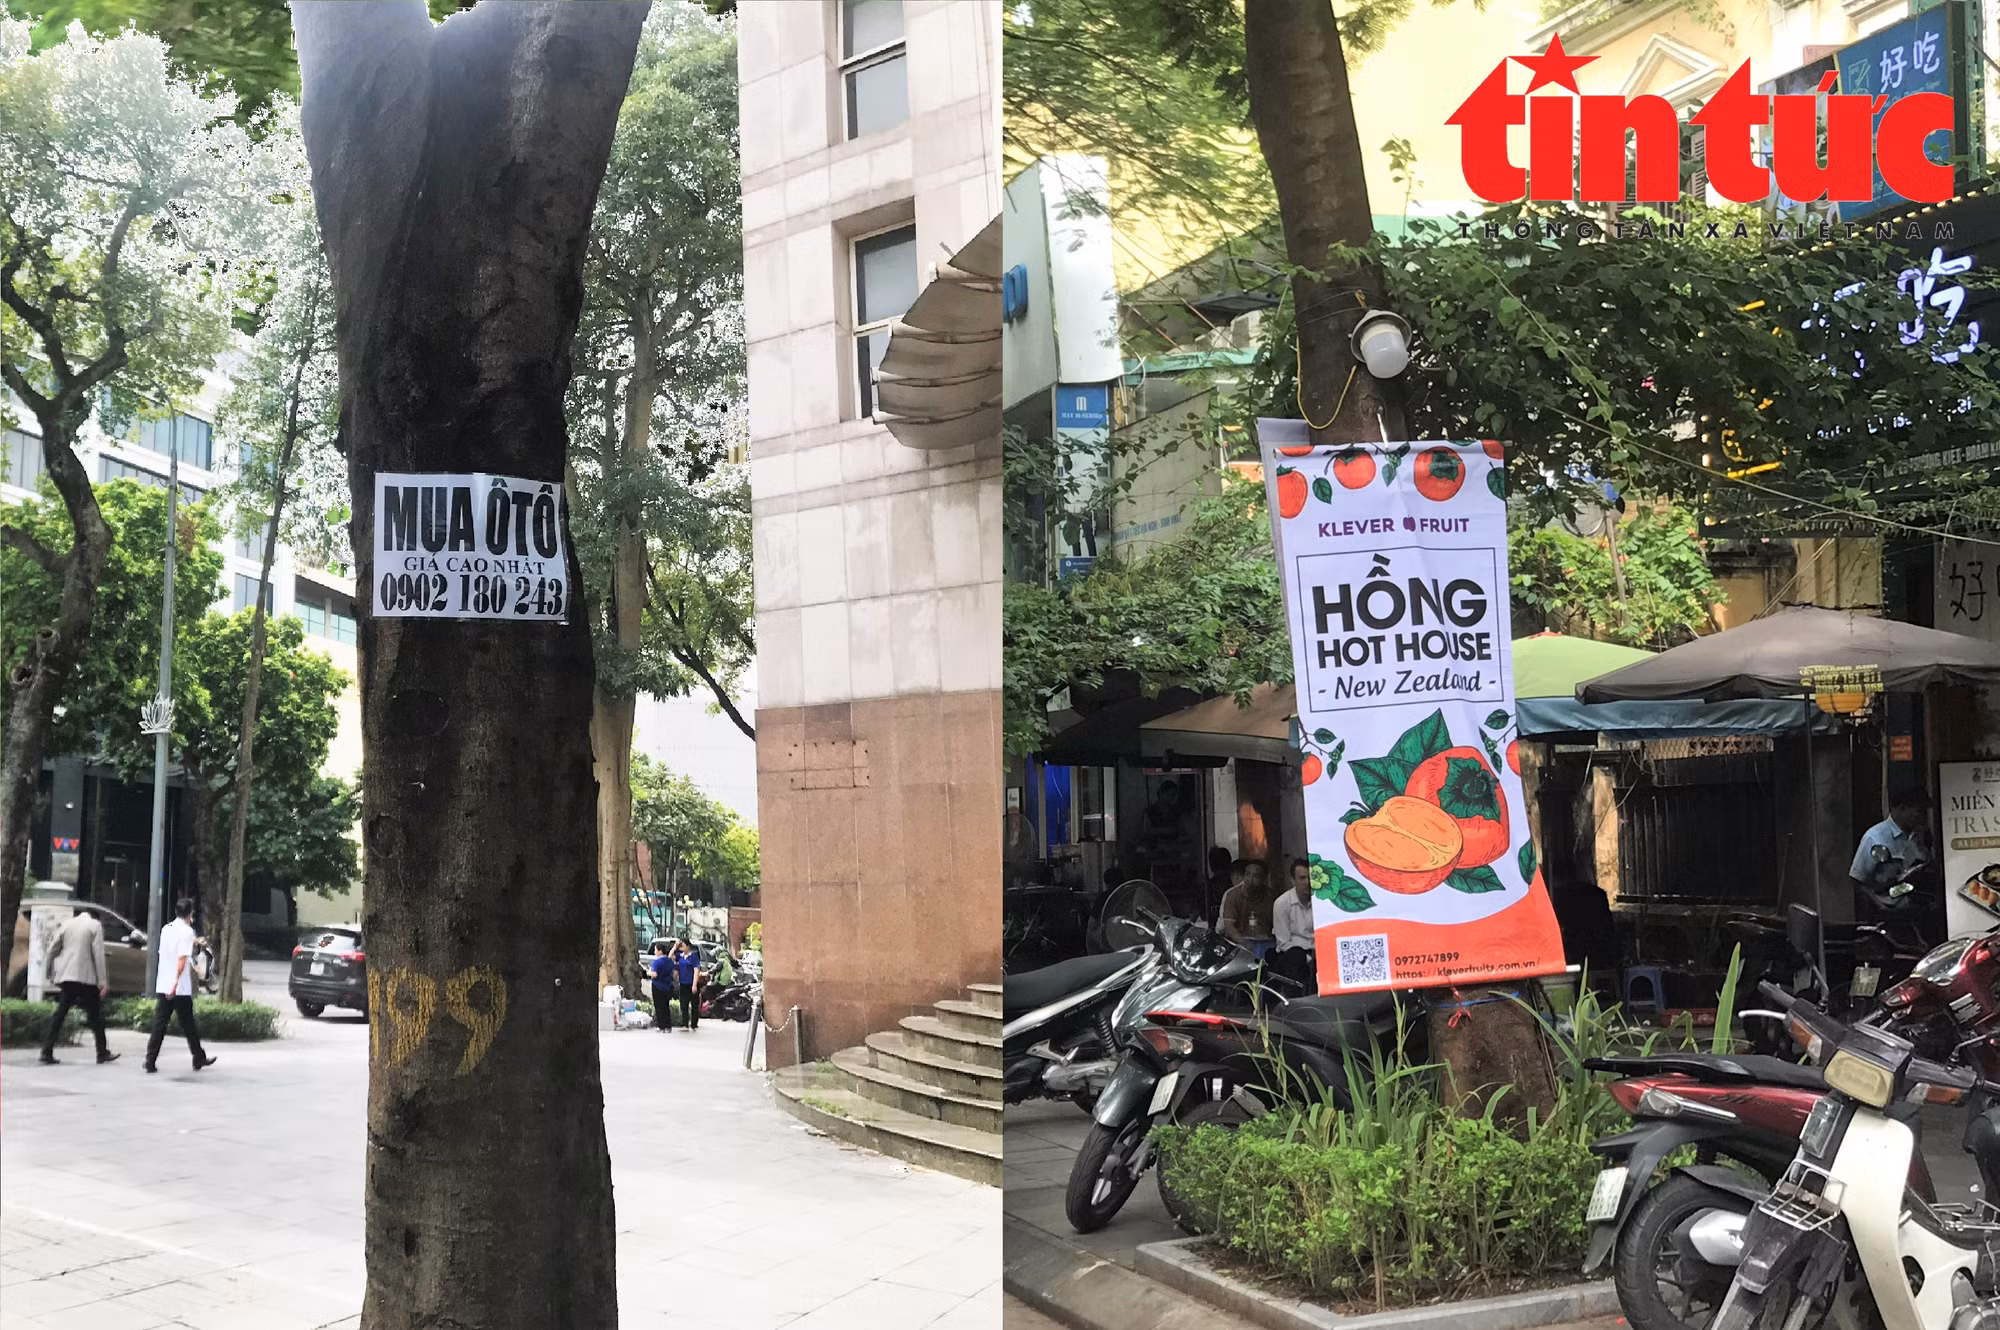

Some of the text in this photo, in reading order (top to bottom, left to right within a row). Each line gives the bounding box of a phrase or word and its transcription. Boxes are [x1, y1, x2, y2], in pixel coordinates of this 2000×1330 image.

[1880, 31, 1940, 93] 好吃
[383, 485, 476, 553] MUA
[1317, 517, 1470, 538] KLEVER FRUIT
[403, 553, 440, 572] GIÁ
[446, 558, 489, 573] CAO
[380, 572, 564, 616] 0902 180 243
[1311, 553, 1488, 635] HỒNG
[1948, 561, 2000, 621] 好
[1316, 629, 1493, 670] HOT HOUSE
[1334, 675, 1387, 700] New
[1393, 667, 1483, 695] Zealand
[1394, 951, 1460, 967] 0972747899
